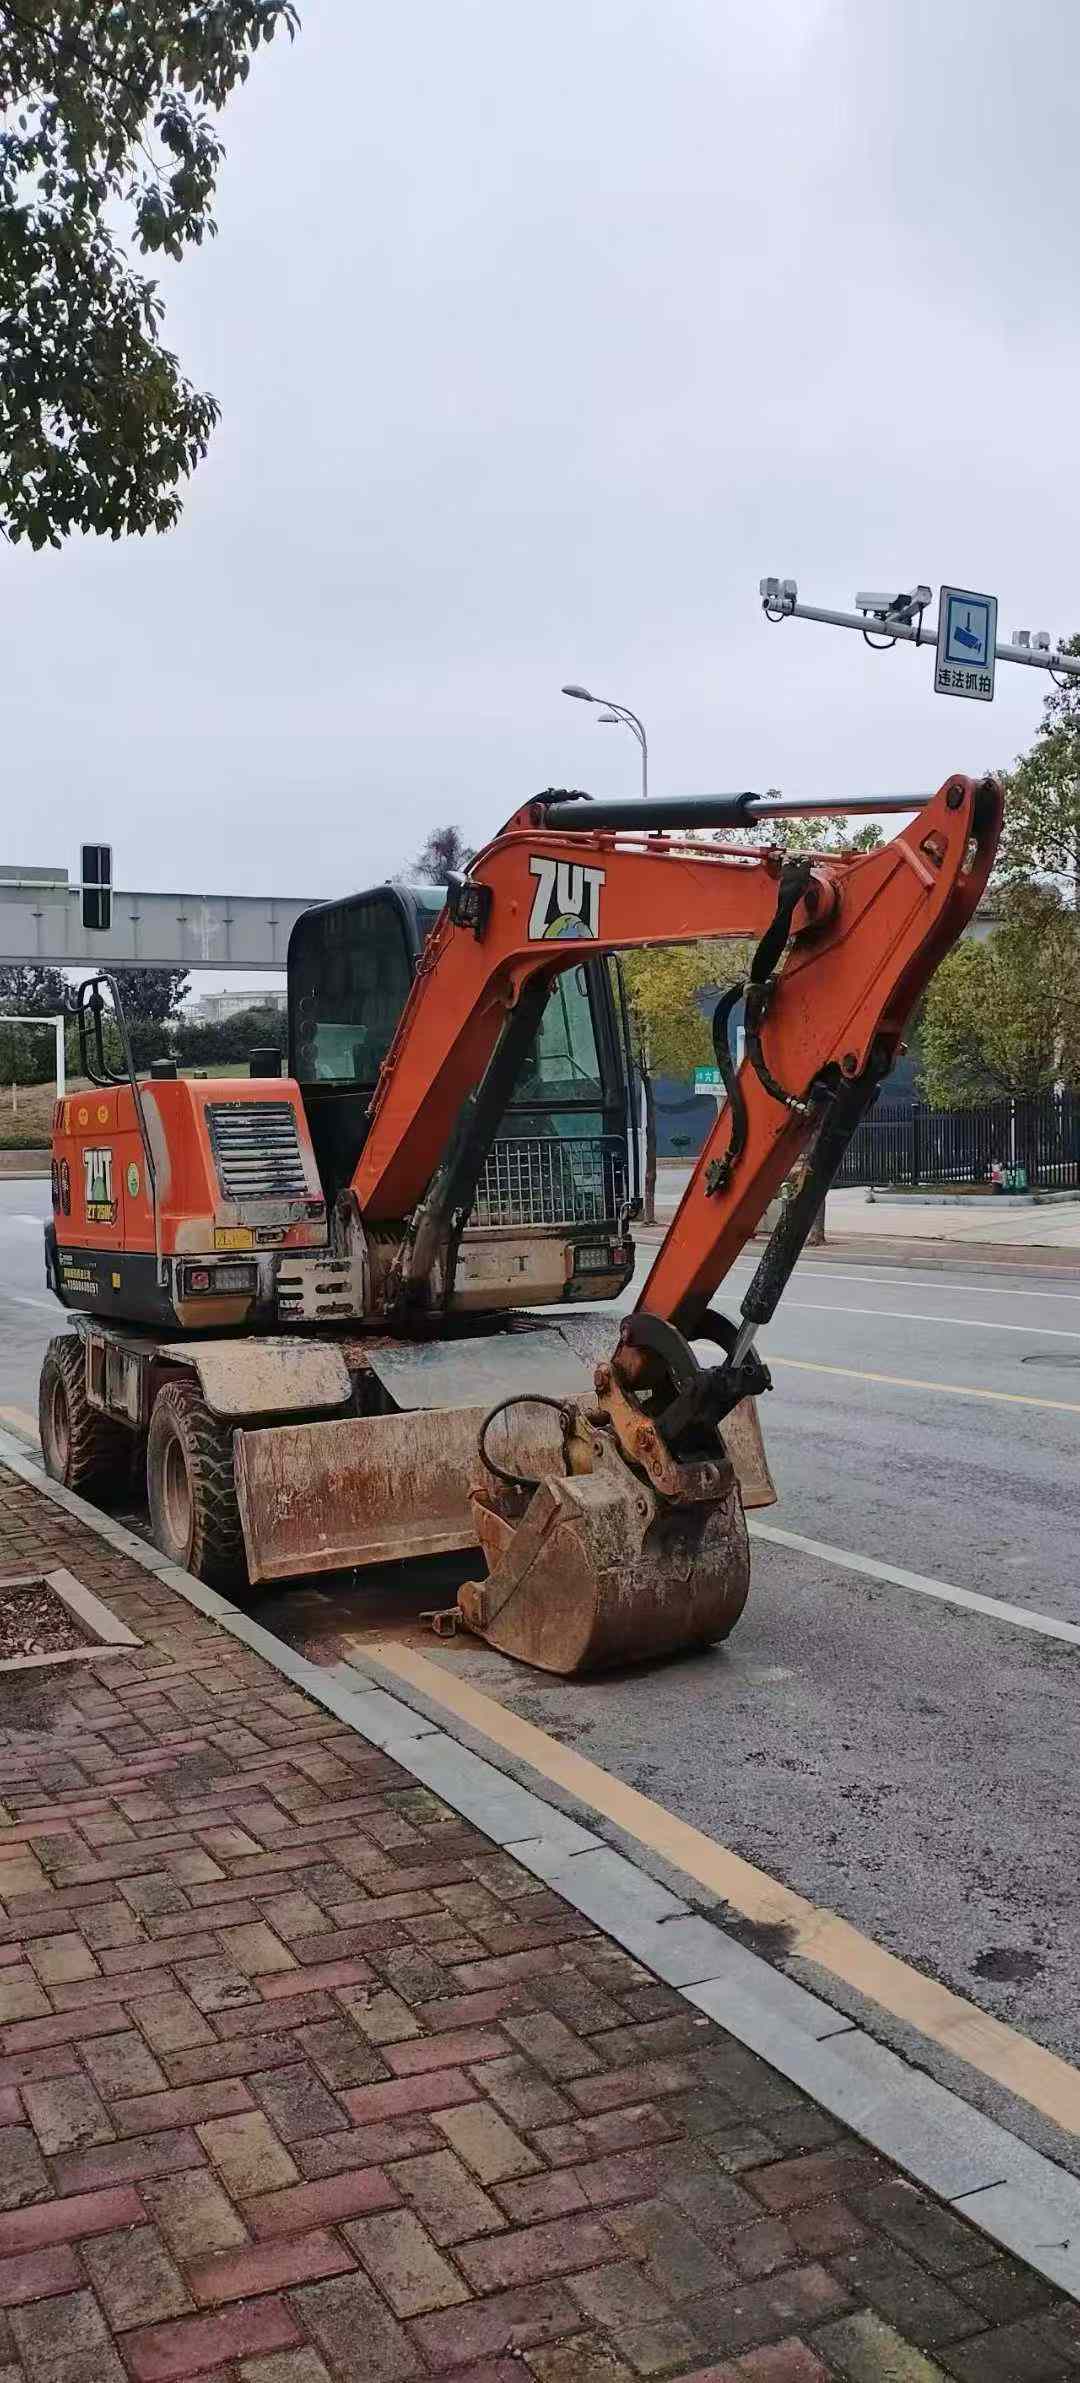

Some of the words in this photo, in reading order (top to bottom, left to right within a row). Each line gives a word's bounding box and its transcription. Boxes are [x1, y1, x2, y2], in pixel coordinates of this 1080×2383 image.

[938, 669, 992, 693] 违法抓拍
[529, 857, 605, 939] ZUT
